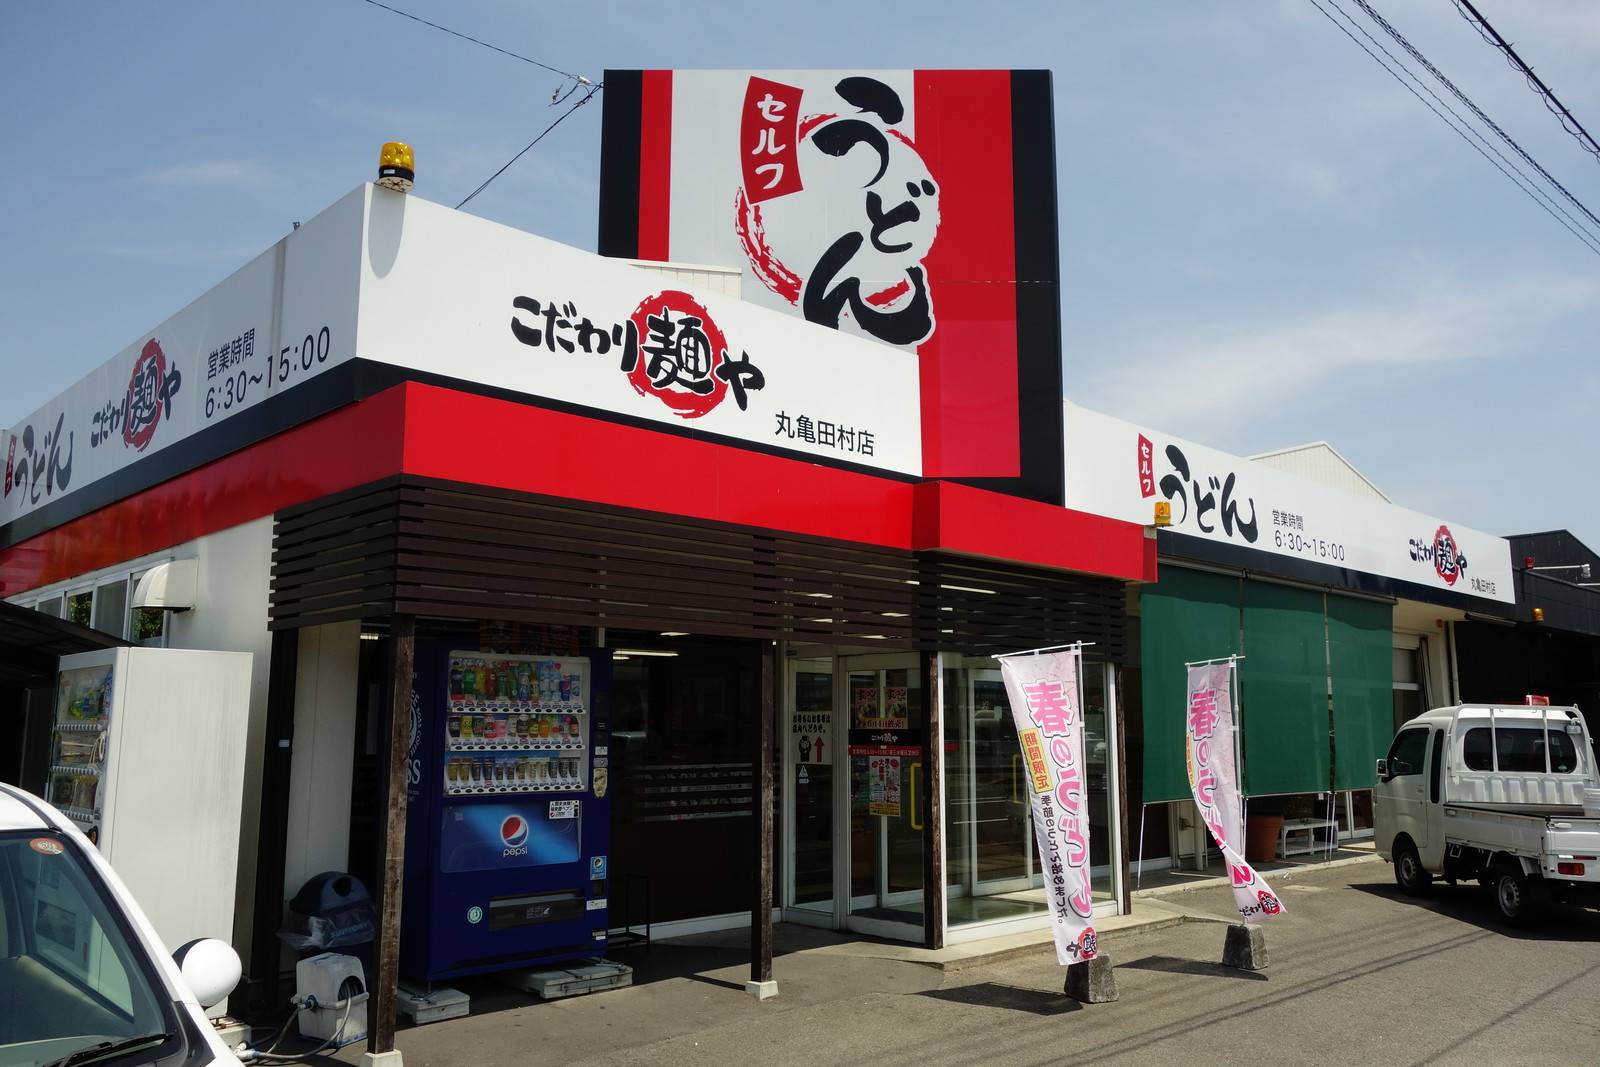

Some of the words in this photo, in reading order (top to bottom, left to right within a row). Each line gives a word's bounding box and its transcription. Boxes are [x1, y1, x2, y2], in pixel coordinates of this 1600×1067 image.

[751, 93, 787, 190] セルフ
[803, 76, 936, 346] うどん
[204, 326, 331, 420] 6:30~15:00
[207, 327, 256, 381] 営業時間
[511, 296, 766, 412] こだわり麺や
[91, 355, 182, 450] こだわり麺や
[774, 410, 875, 458] 丸亀田村店
[15, 412, 74, 508] うどん
[1140, 441, 1153, 495] セルフ
[1159, 444, 1259, 544] うどん
[1271, 508, 1304, 532] 営業時間
[1274, 532, 1346, 562] 6:30~15:00
[503, 847, 528, 857] pepsi
